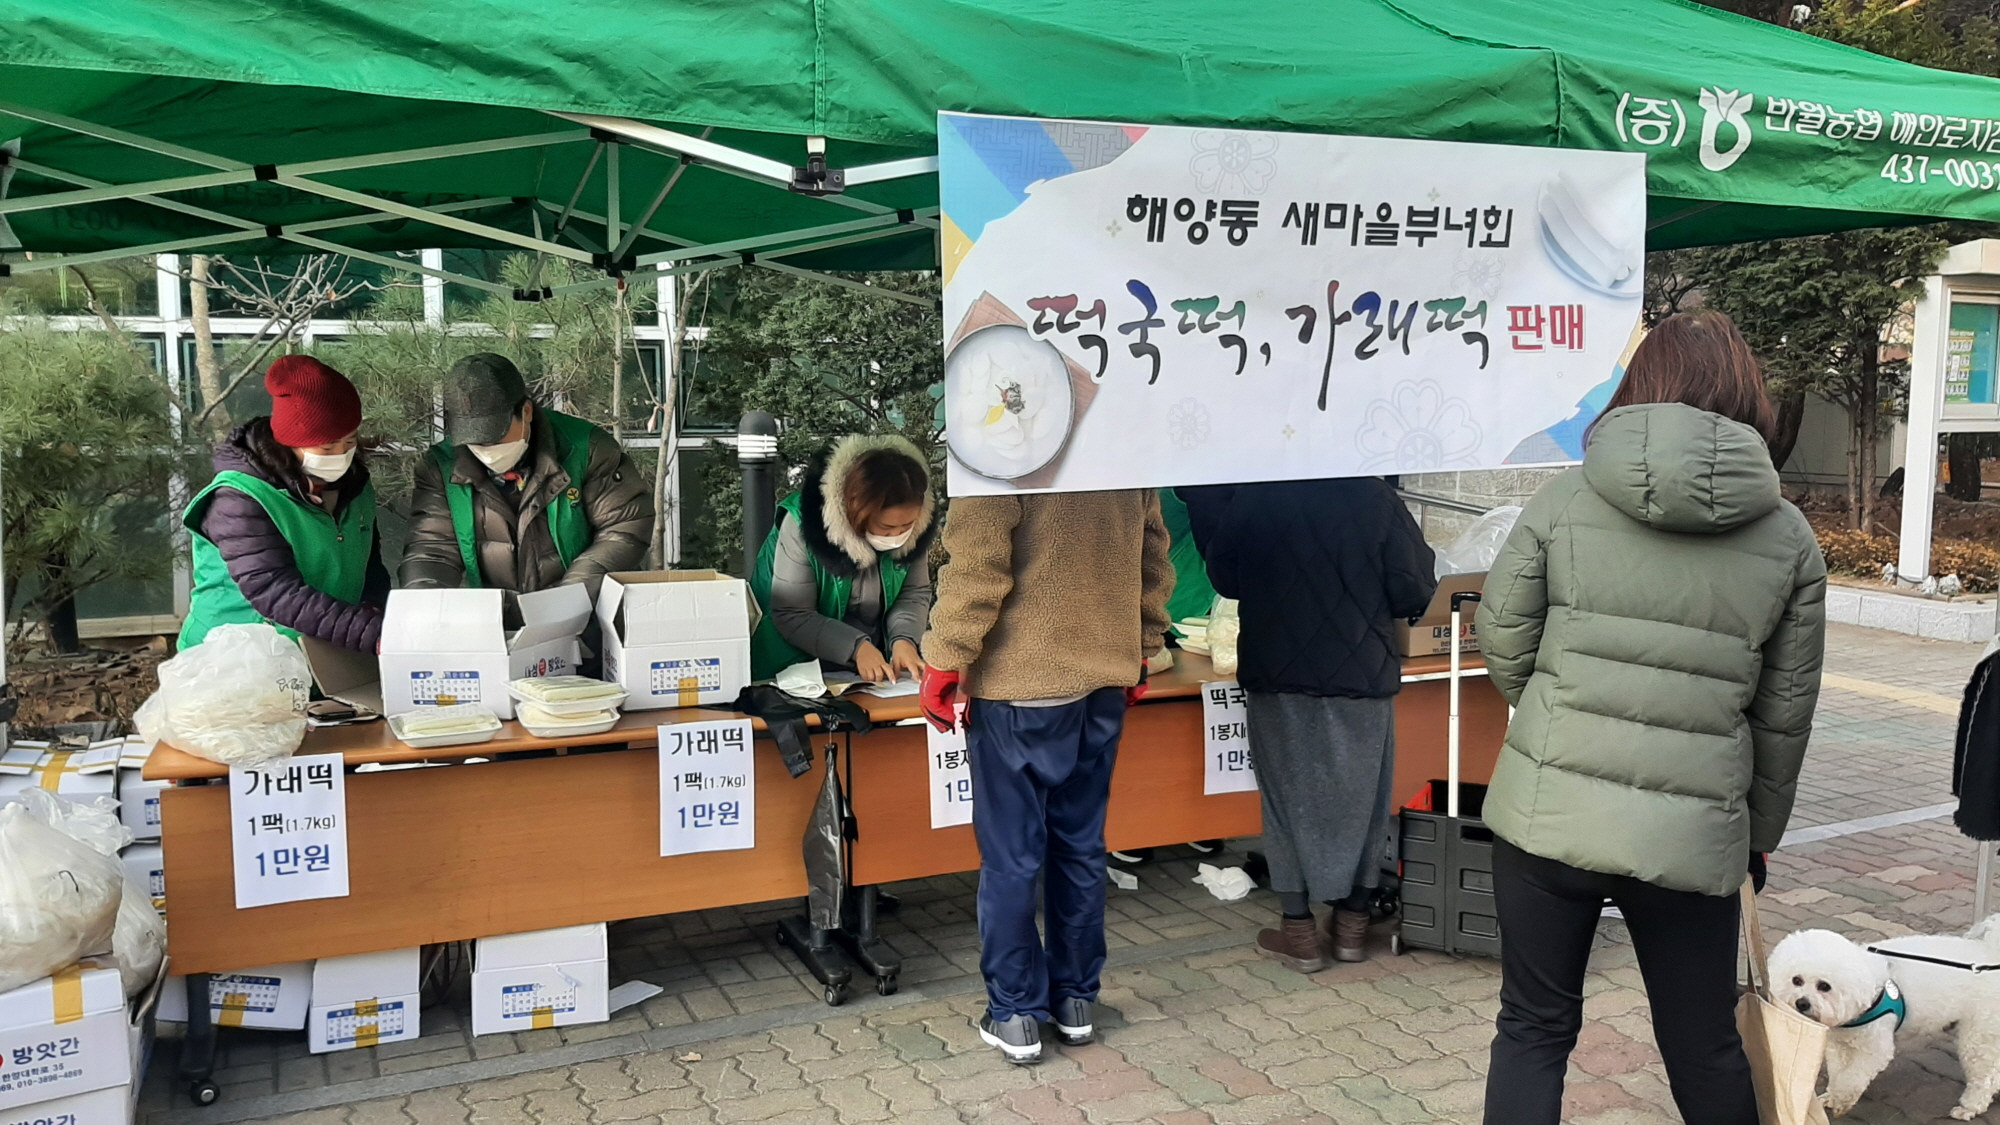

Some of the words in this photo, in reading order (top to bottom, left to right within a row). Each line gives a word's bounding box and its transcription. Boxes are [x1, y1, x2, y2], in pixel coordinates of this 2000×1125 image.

[1616, 91, 1687, 148] (증)
[1765, 96, 1884, 141] 반월농협
[1126, 194, 1260, 247] 해양동
[1281, 201, 1514, 249] 새마을부녀회
[1506, 304, 1585, 351] 판매
[670, 727, 745, 757] 가래떡
[1216, 749, 1254, 772] 1만
[243, 763, 333, 796] 가래떡
[677, 800, 740, 829] 1만원
[255, 843, 331, 877] 1만원
[12, 1036, 80, 1065] 방앗간
